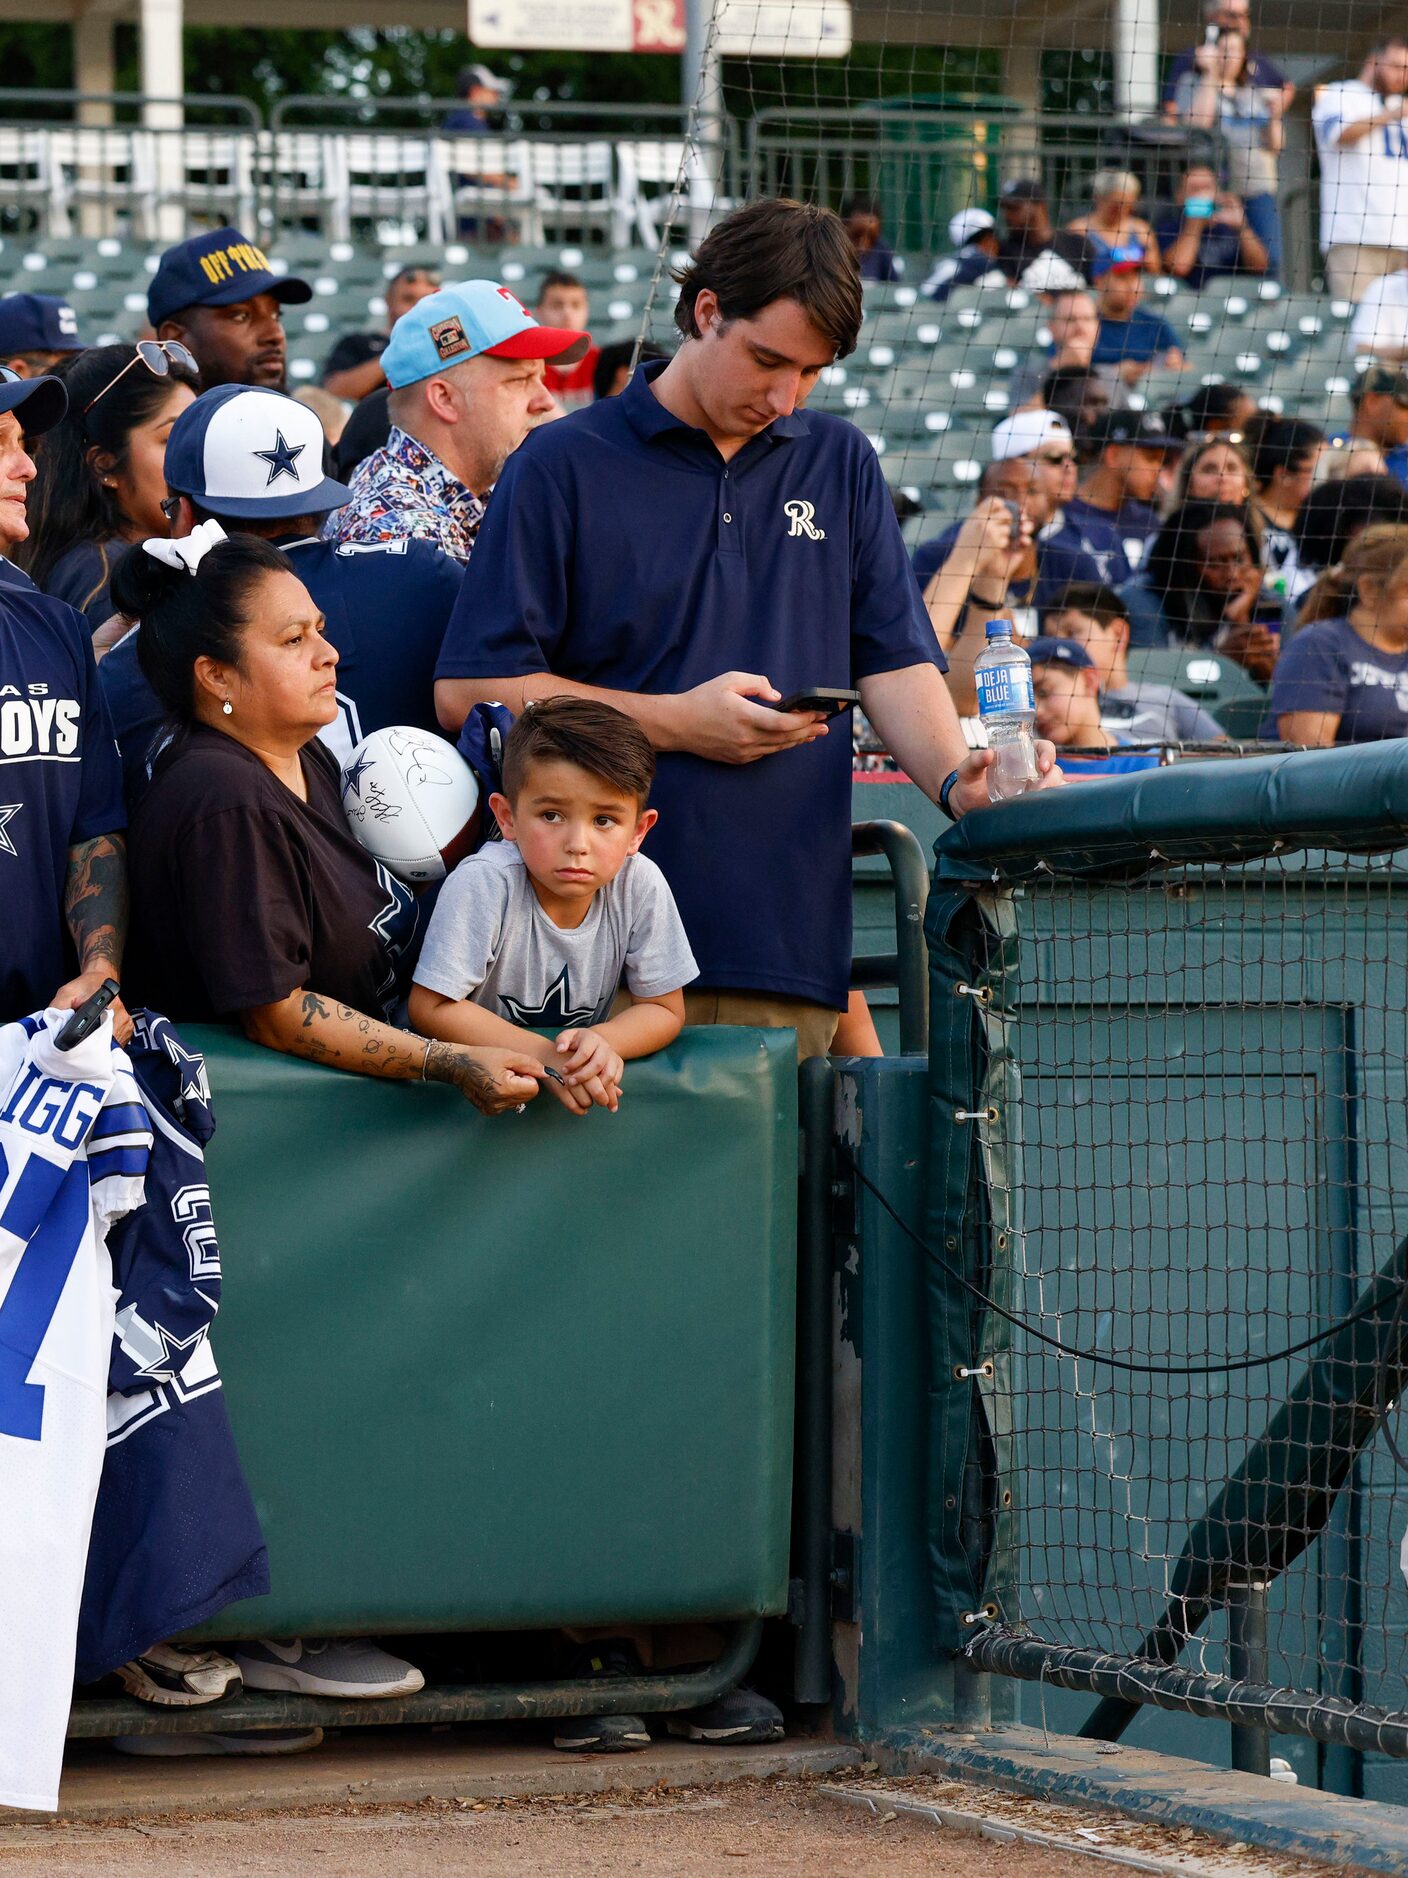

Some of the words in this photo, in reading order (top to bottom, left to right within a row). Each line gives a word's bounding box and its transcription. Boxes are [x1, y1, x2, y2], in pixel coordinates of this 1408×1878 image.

[784, 499, 826, 540] R
[983, 669, 1008, 687] DEJA
[985, 685, 1010, 704] BLUE
